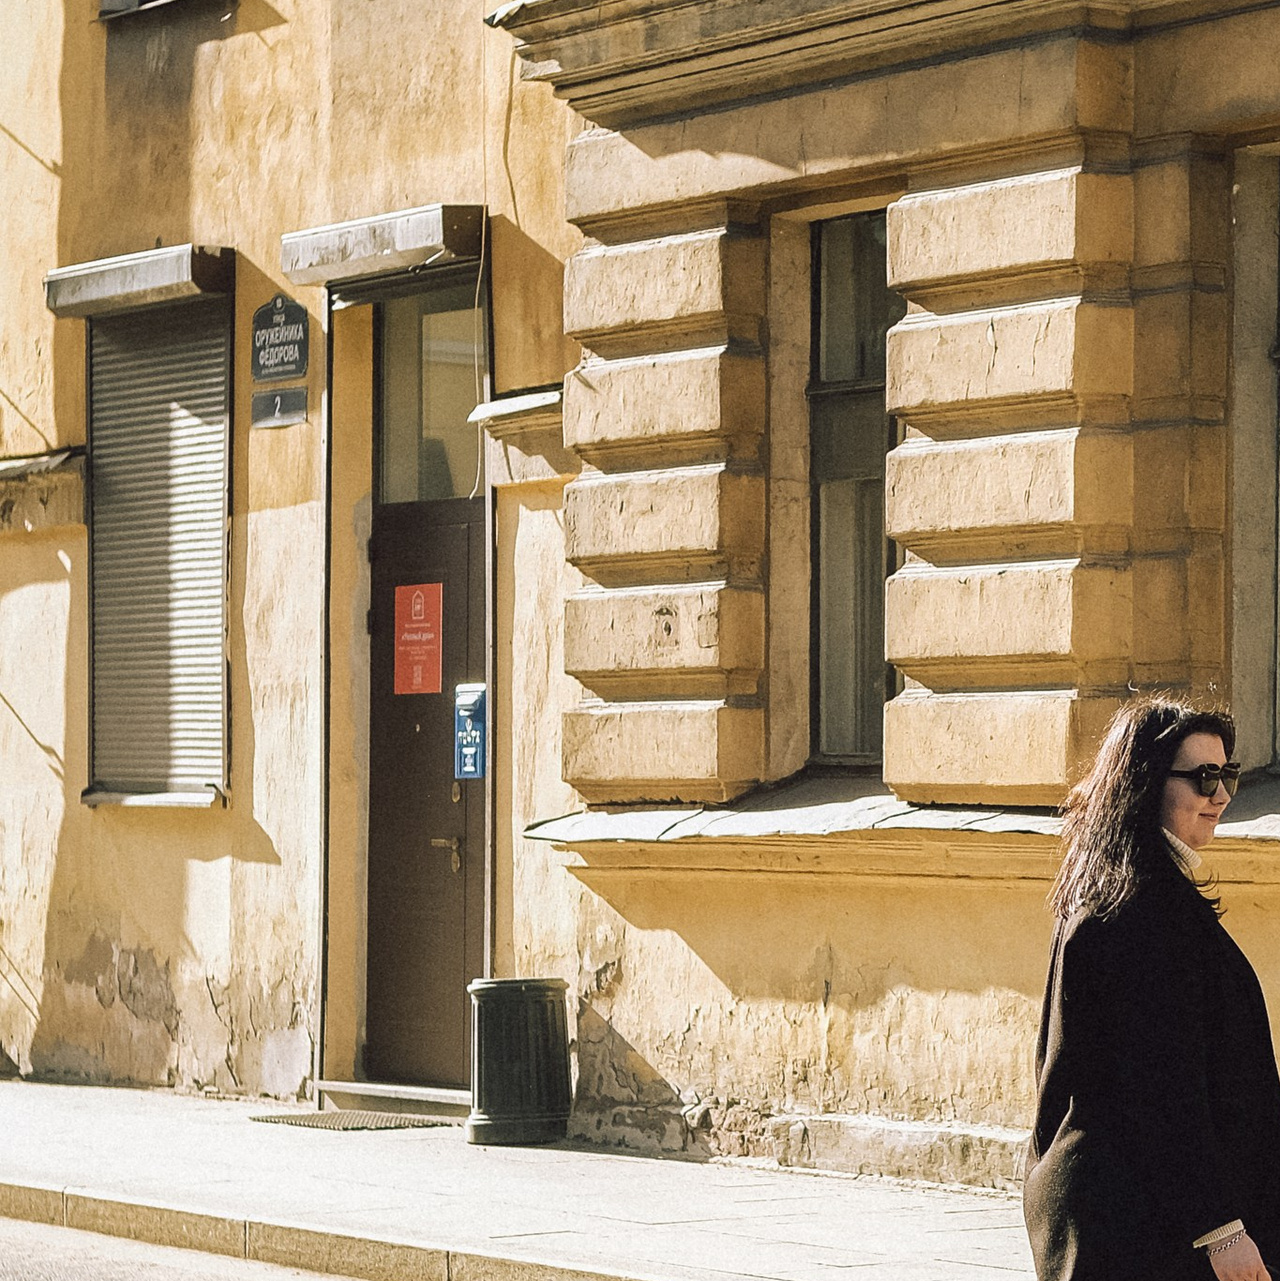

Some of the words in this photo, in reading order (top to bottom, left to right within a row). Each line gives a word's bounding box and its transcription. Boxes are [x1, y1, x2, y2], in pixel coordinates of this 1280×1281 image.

[255, 323, 304, 348] ОРУЖЕЙНИКА
[258, 344, 300, 367] ФЁДОРОВА
[274, 395, 281, 418] 2
